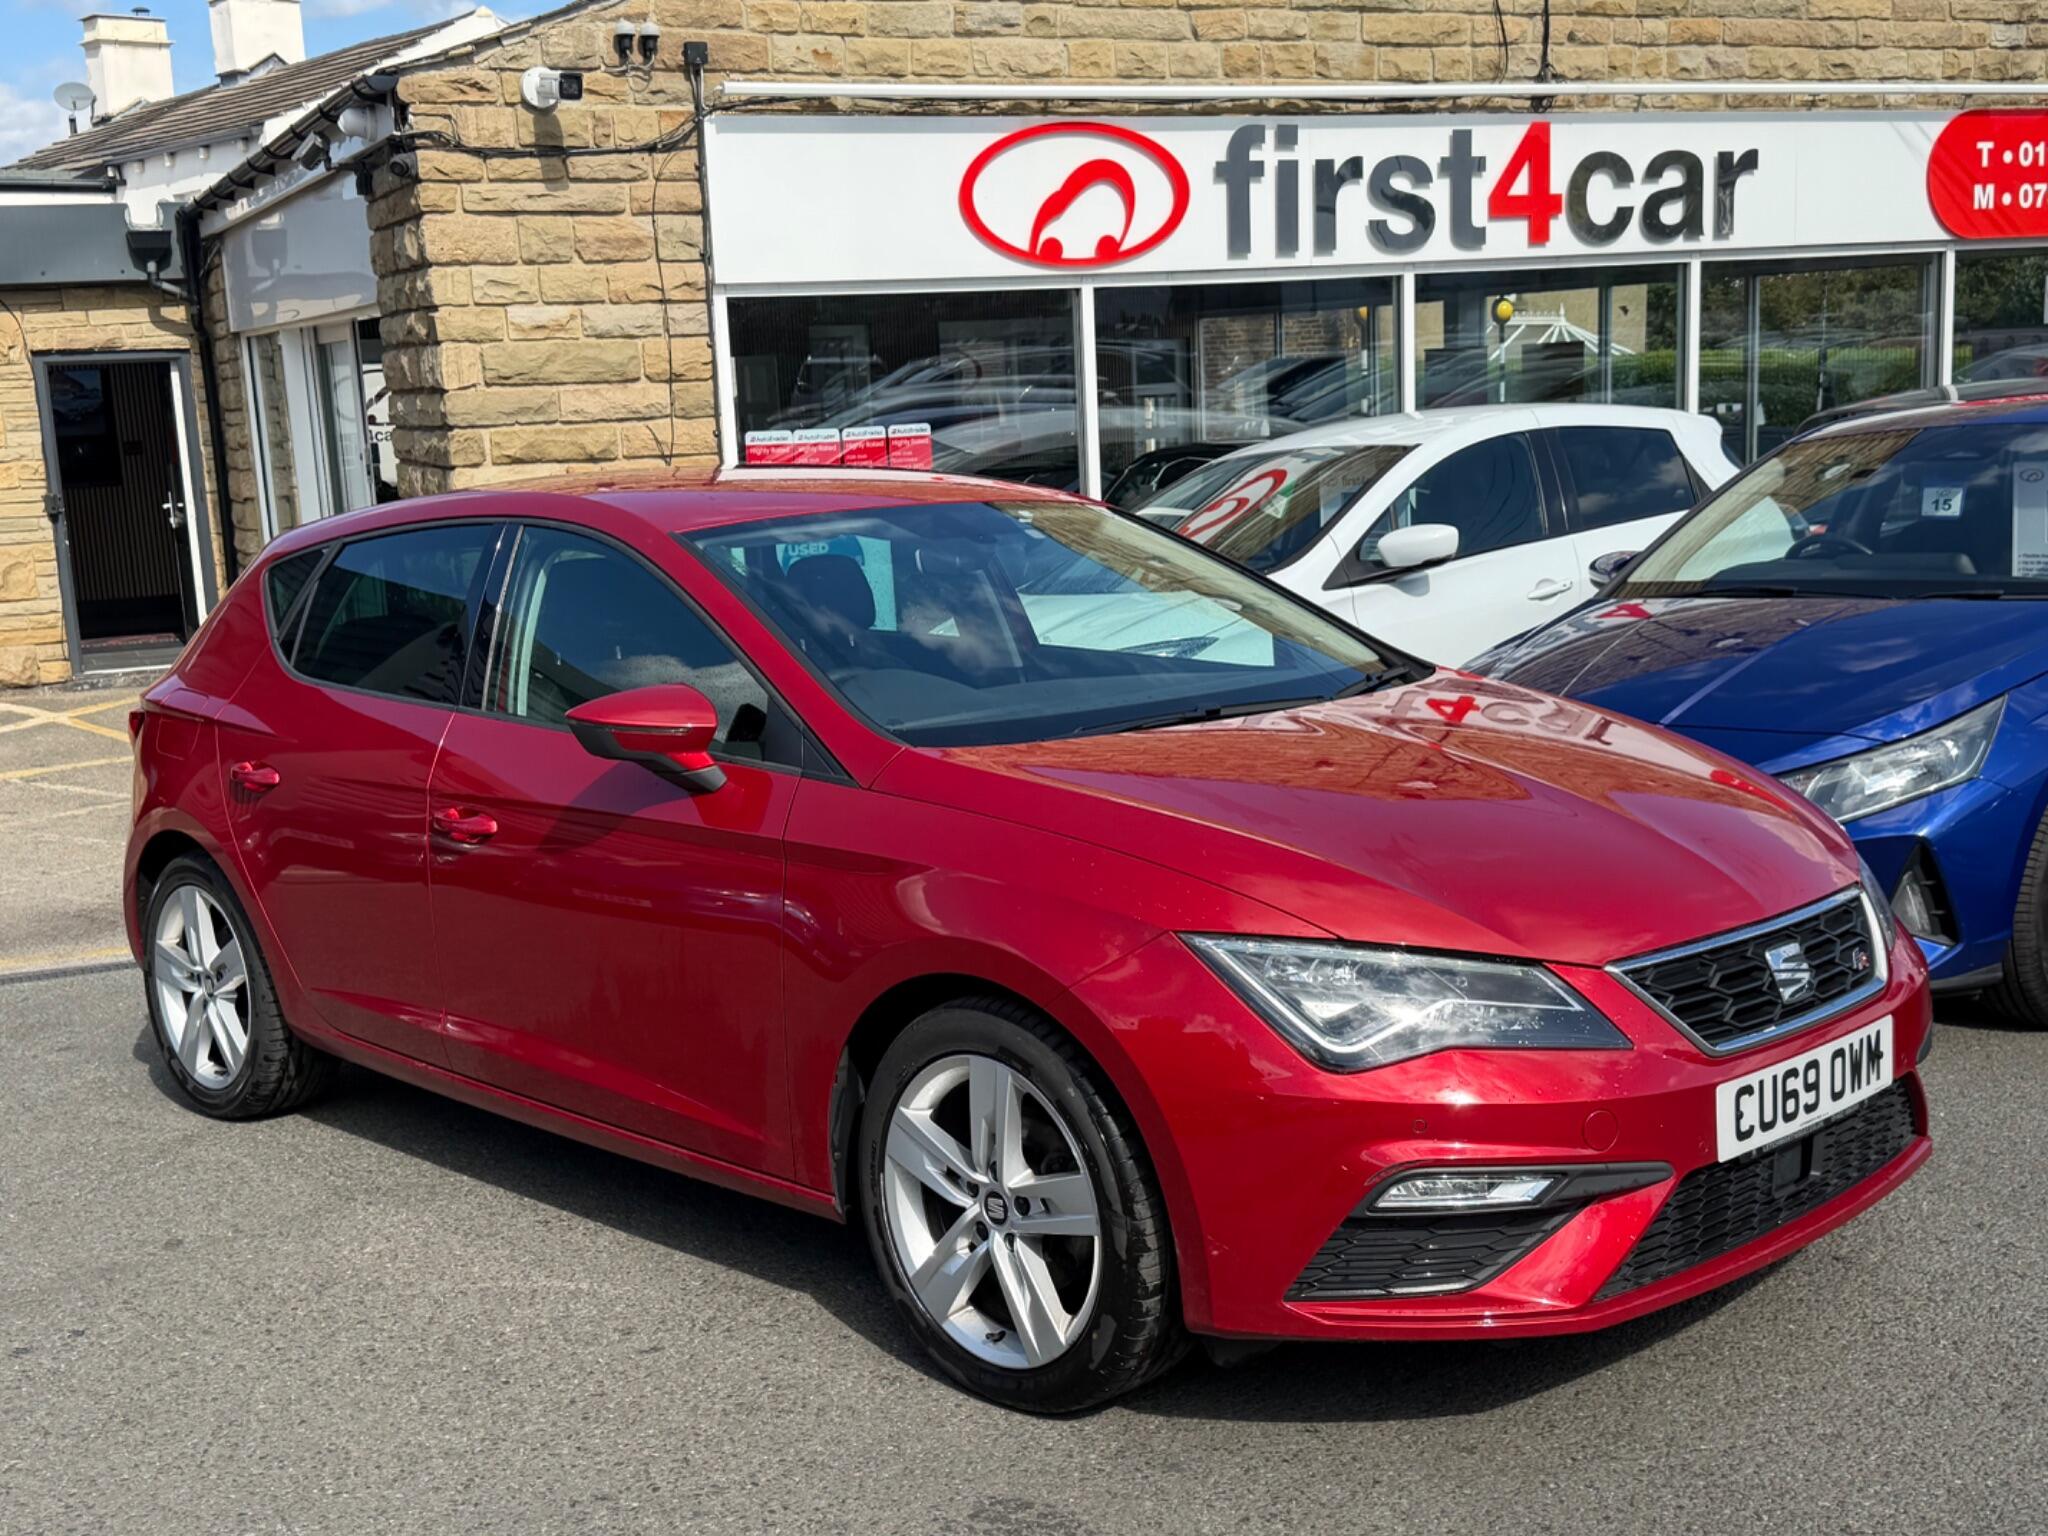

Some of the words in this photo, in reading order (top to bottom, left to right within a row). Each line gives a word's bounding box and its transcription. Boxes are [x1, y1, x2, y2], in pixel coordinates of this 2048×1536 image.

[1976, 141, 1995, 168] T
[1215, 121, 1758, 258] first4car
[1973, 183, 1995, 210] M
[1931, 498, 1953, 512] 15
[788, 543, 829, 556] USED
[1735, 1058, 1820, 1142] CU69
[1830, 1028, 1884, 1103] OWM
